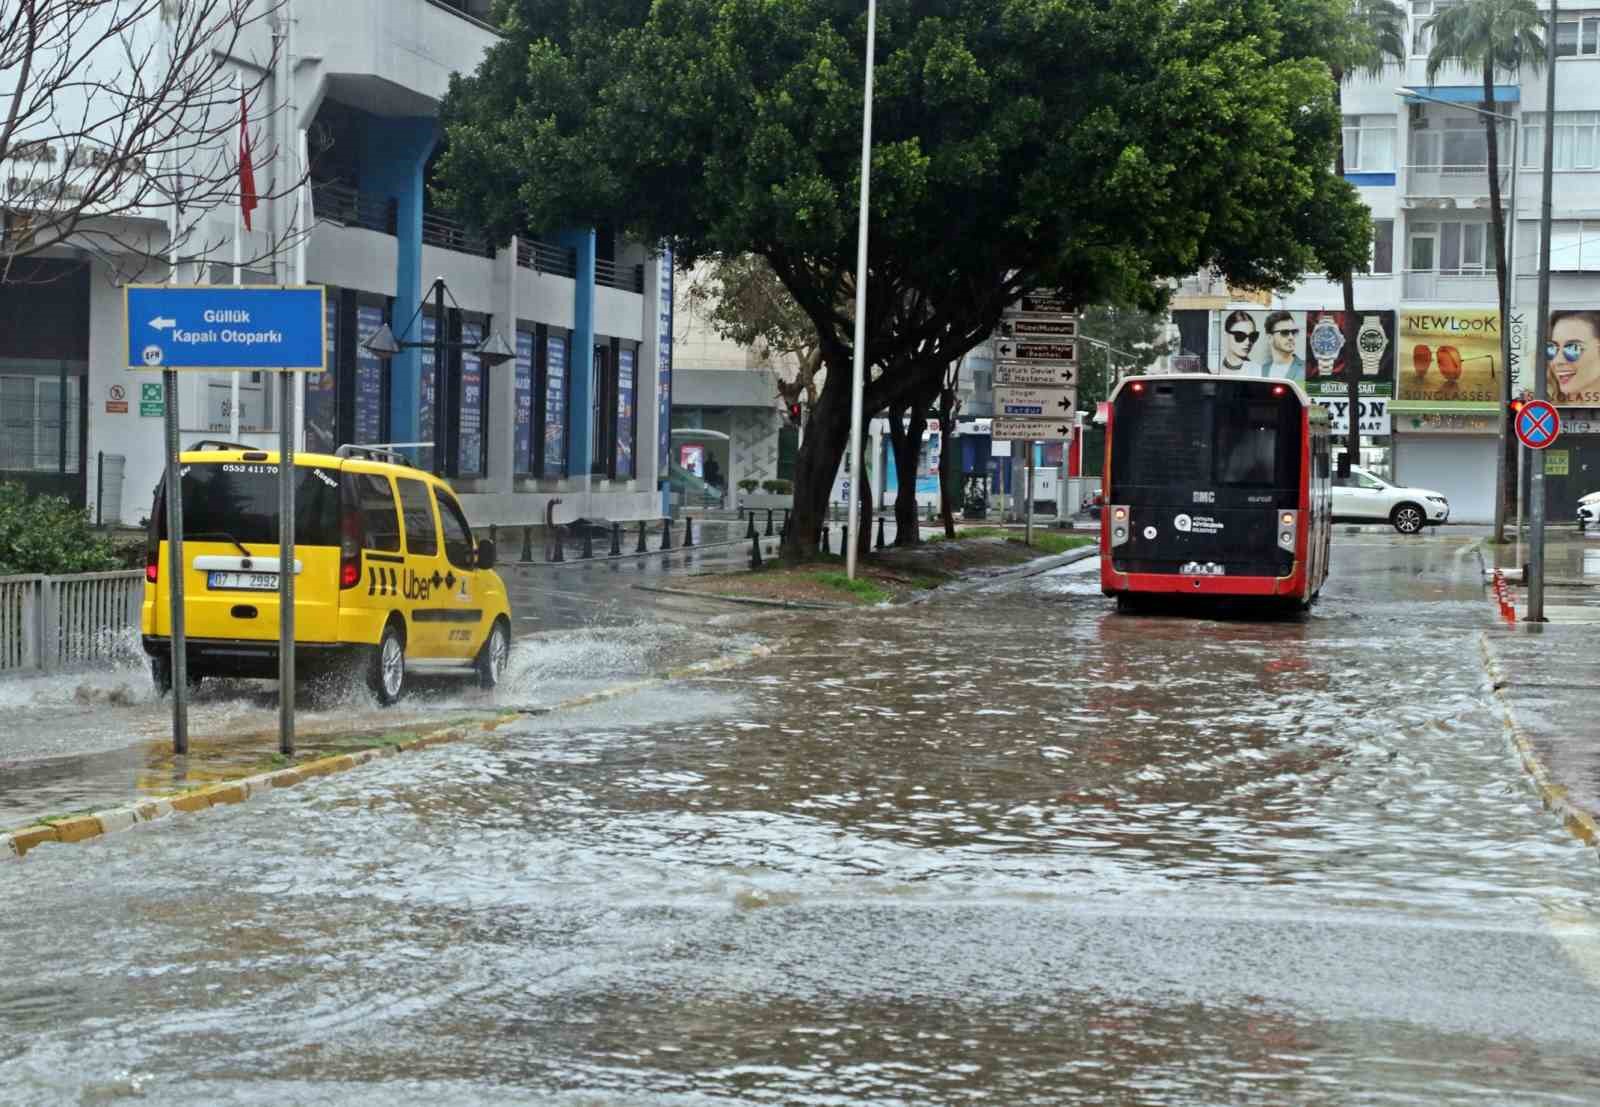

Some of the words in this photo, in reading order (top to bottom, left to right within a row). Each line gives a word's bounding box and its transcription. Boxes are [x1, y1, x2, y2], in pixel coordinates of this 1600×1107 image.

[203, 309, 250, 323] Güllük
[172, 329, 217, 345] Kapalı
[221, 329, 282, 345] Otoparkı
[1358, 383, 1376, 393] SAAT
[1193, 491, 1216, 503] BMC
[215, 573, 226, 586] 07
[250, 574, 277, 587] 2992
[403, 568, 432, 600] Uber
